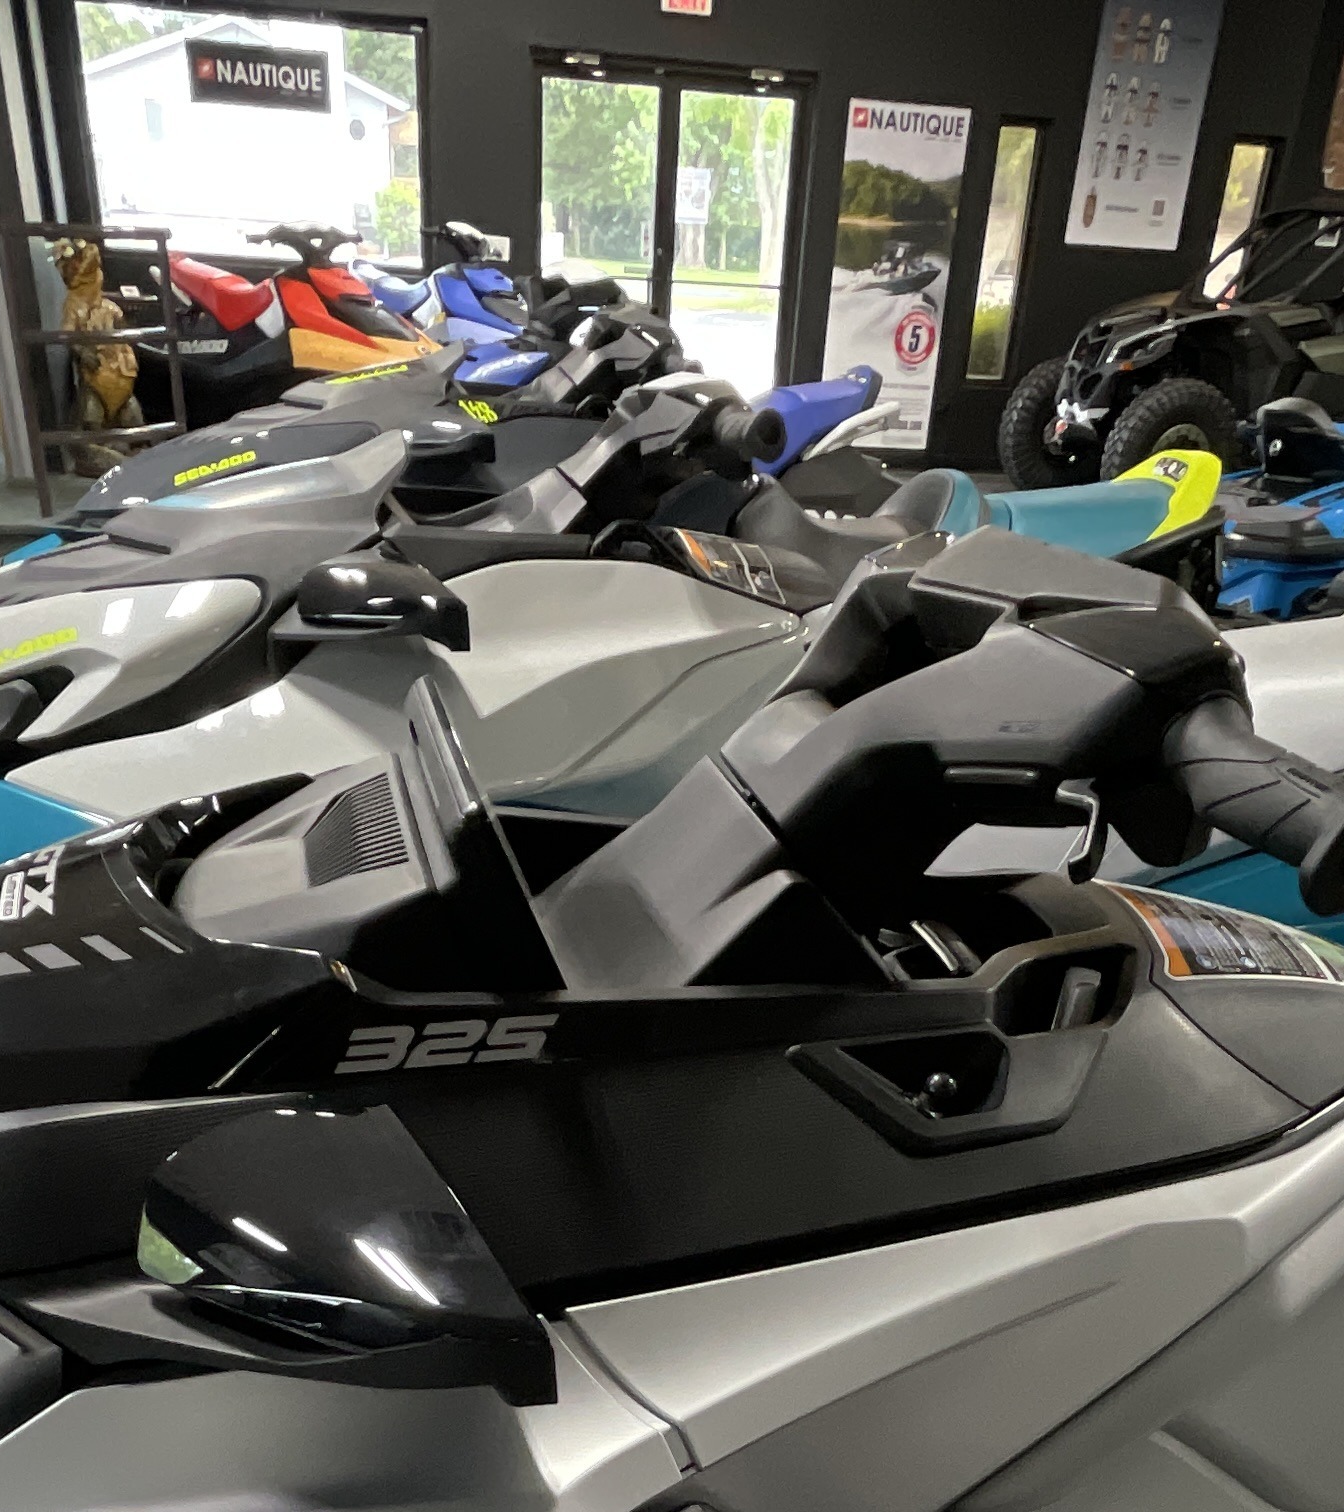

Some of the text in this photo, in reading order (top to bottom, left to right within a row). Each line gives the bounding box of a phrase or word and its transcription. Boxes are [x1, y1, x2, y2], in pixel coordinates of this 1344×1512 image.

[216, 58, 323, 92] NAUTIQUE
[869, 107, 966, 137] NAUTIQUE
[907, 325, 923, 352] 5
[334, 1013, 560, 1075] 325
